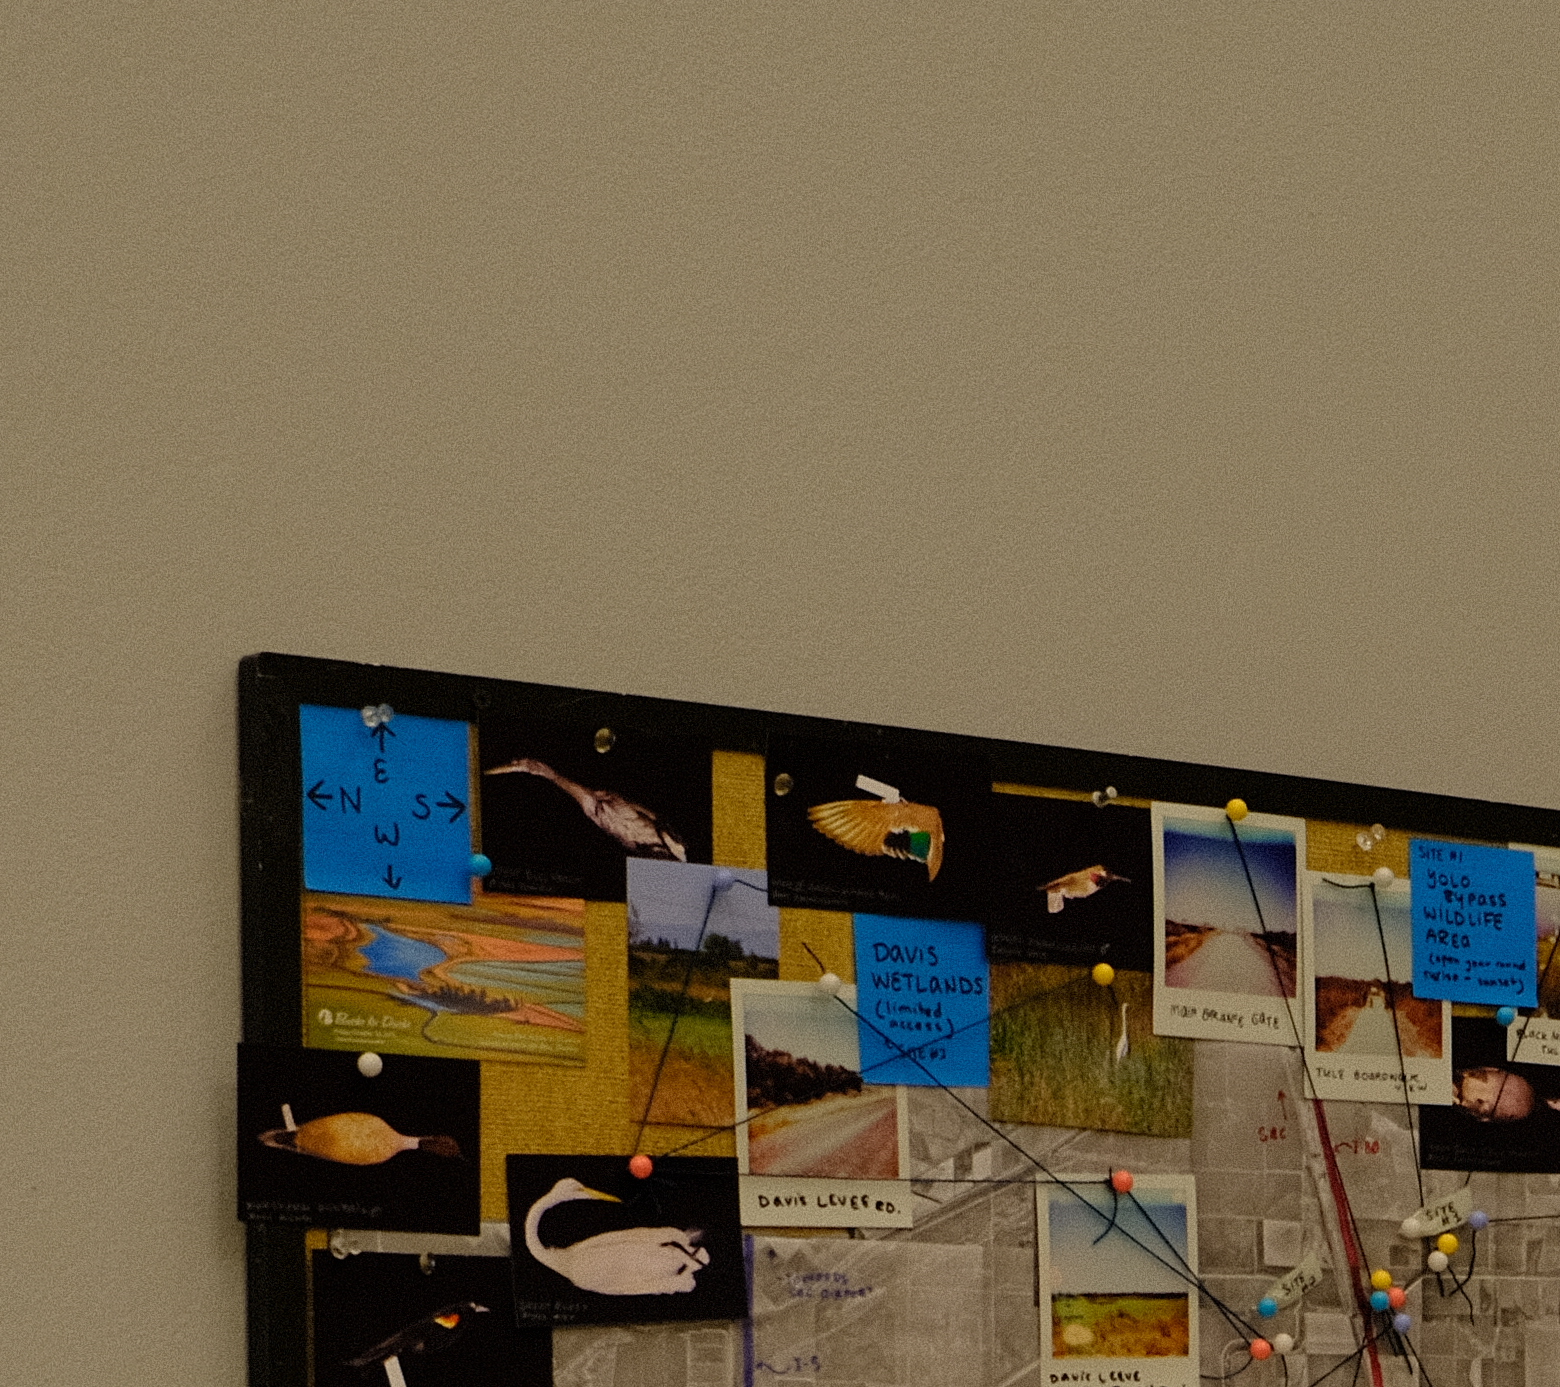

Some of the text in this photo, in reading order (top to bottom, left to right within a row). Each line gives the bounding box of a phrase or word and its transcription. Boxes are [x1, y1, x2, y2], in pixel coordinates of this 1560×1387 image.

[341, 787, 430, 820] N S
[375, 822, 399, 846] W
